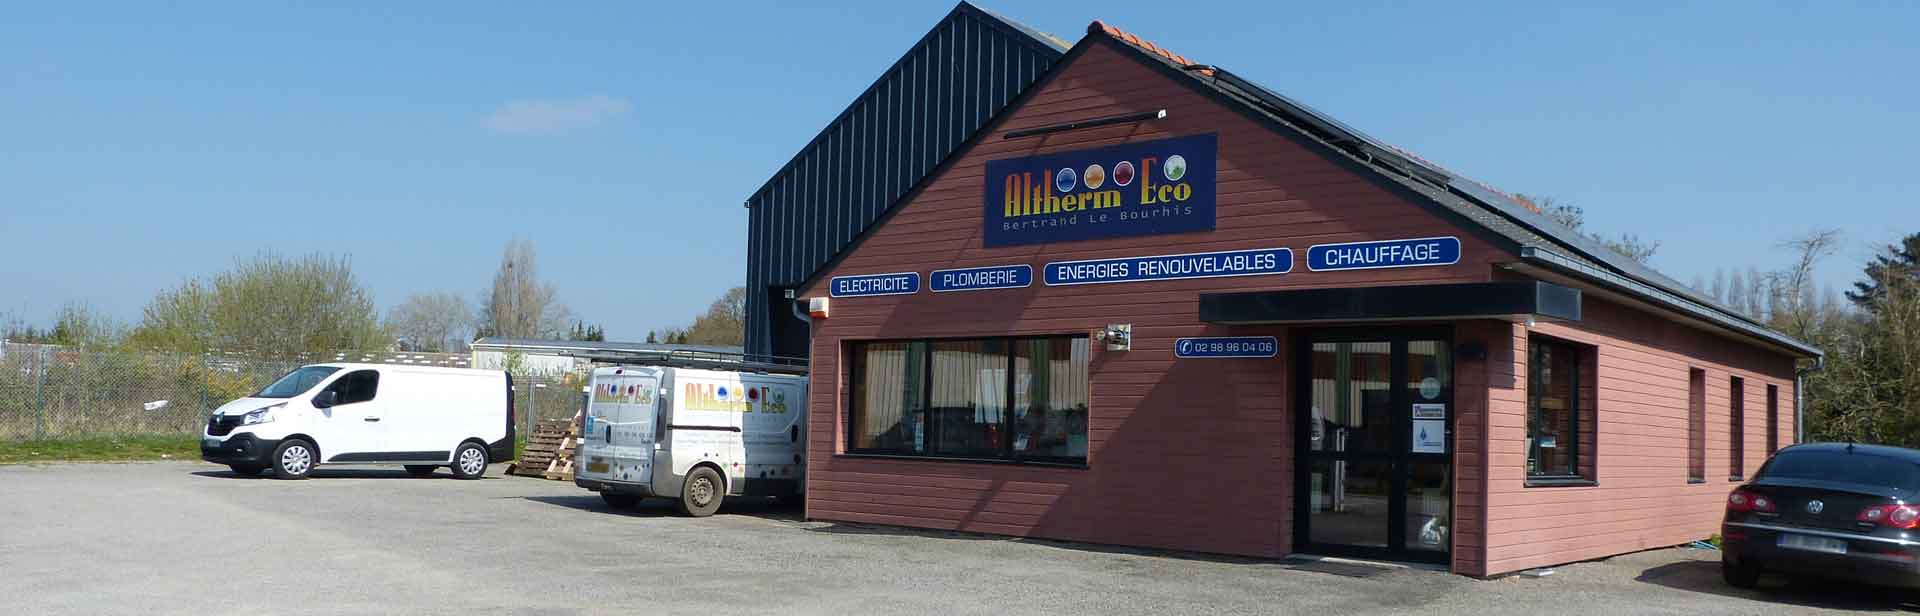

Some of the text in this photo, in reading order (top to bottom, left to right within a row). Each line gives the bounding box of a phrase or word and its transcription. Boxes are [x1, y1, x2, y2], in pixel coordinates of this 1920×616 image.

[1004, 156, 1192, 217] Altherm Eco
[1003, 205, 1192, 231] Bertrand Le Bourhis
[1325, 243, 1440, 266] CHAUFFAGE
[1058, 253, 1276, 280] ENERGIES RENOUVELABLES
[839, 276, 909, 293] ELECTRICITE
[943, 270, 1017, 287] PLOMBERIE
[1194, 343, 1273, 352] 02 98 96 04 06
